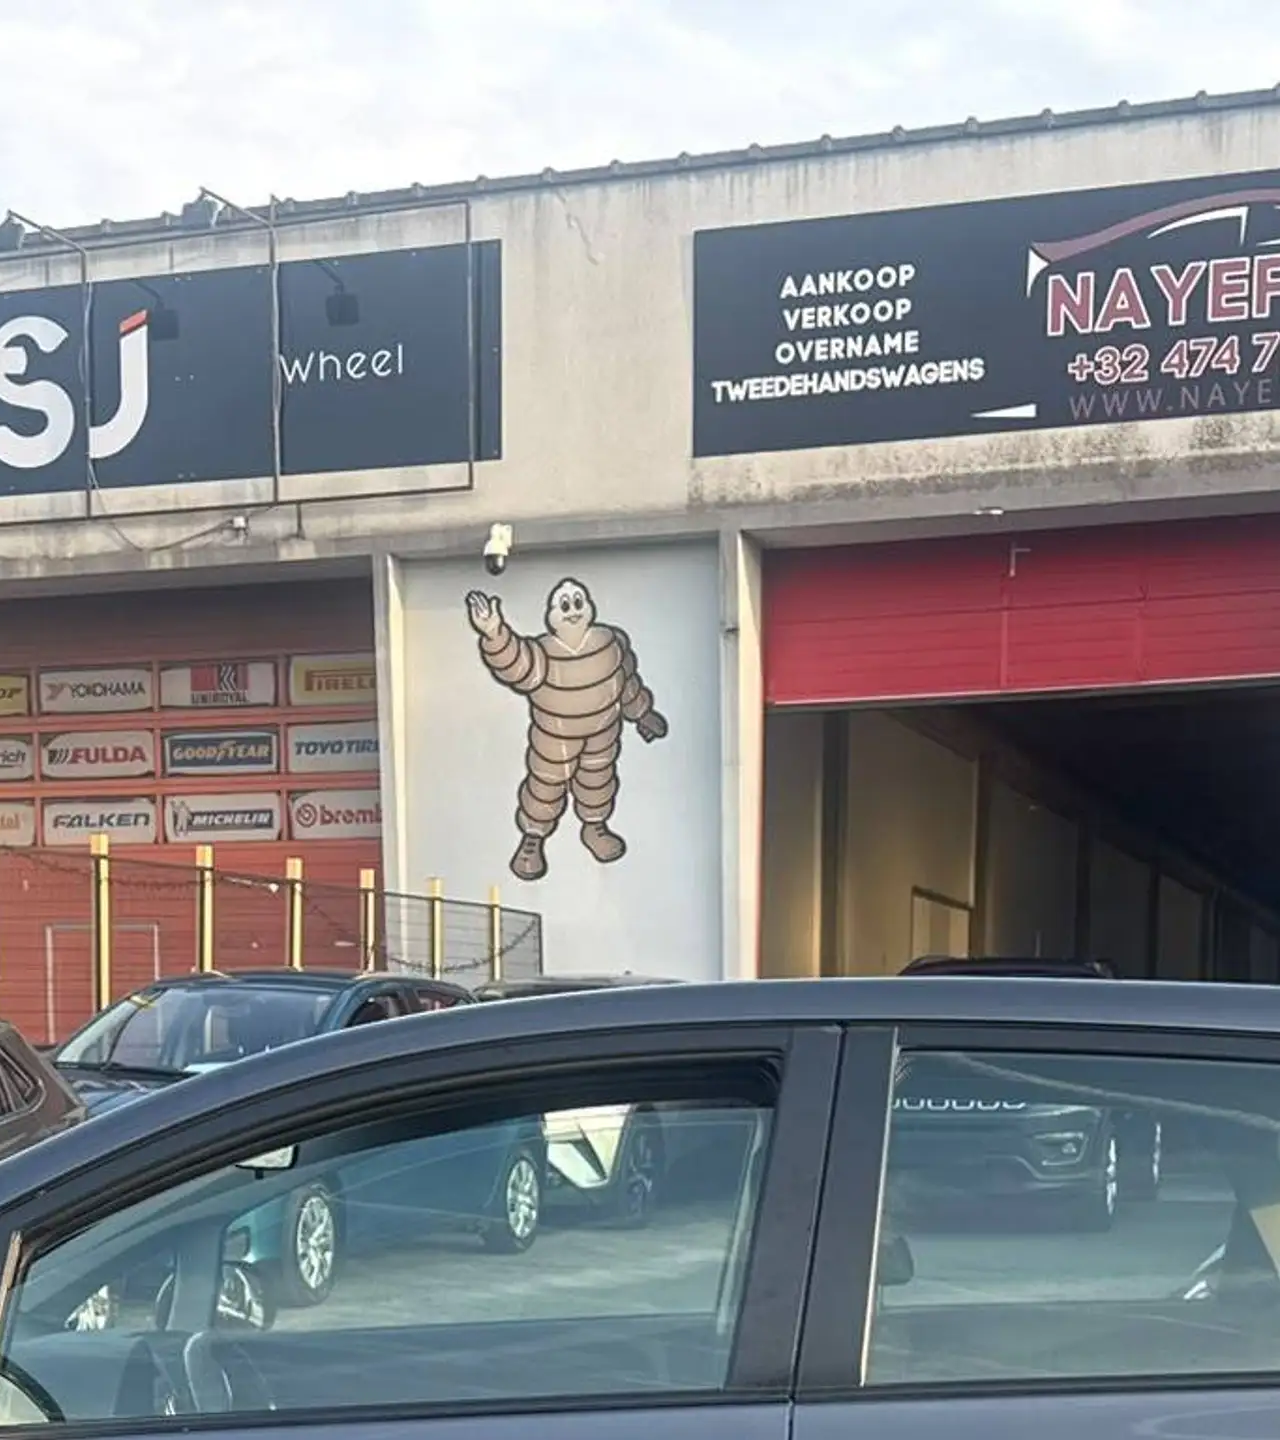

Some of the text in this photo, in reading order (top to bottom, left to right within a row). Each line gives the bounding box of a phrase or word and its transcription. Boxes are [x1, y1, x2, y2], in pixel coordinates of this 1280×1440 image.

[780, 264, 916, 299] AANKOOP
[783, 298, 913, 332] VERKOOP
[774, 331, 920, 365] OVERNAME
[280, 343, 406, 385] Wheel
[1067, 344, 1150, 385] +32
[1160, 335, 1241, 379] 474
[712, 357, 985, 403] TWEEDEHANDSWAGENS
[70, 681, 146, 699] YOKOHAMA
[304, 667, 377, 691] PIREL
[71, 746, 147, 765] FULDA
[173, 741, 269, 762] GOODYEAR
[294, 739, 380, 756] TOYO TIR
[52, 812, 150, 829] FALKEN
[192, 812, 270, 826] MICHELIN
[320, 804, 382, 825] brem
